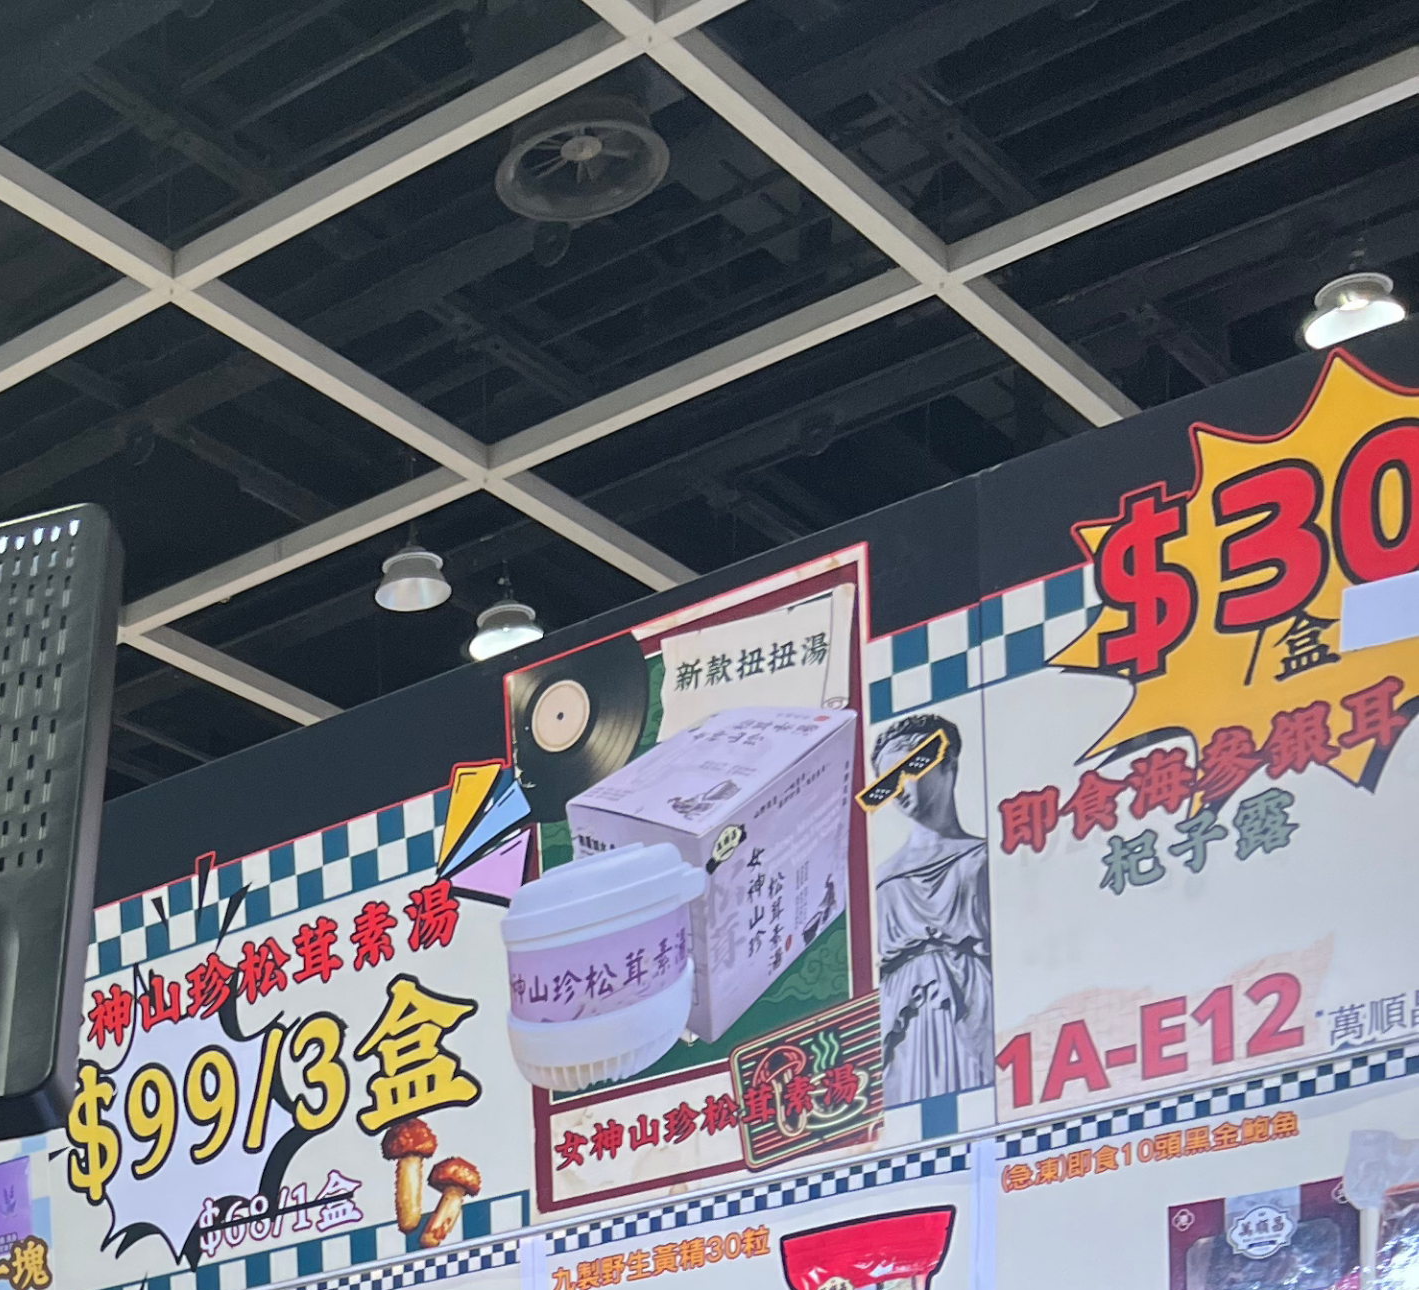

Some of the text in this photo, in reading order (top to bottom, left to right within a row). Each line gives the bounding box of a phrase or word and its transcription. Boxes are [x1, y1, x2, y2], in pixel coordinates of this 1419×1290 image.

[674, 631, 831, 692] 新款扭扭湯
[999, 675, 1409, 856] 即食海參銀耳
[1099, 787, 1299, 895] 杞子露
[87, 878, 462, 1049] 神山珍松茸素湯
[1328, 989, 1419, 1046] 萬順
[67, 973, 482, 1204] $99/3盒
[995, 972, 1304, 1109] 1A-E12
[555, 1064, 859, 1171] 女神山珍松茸素湯
